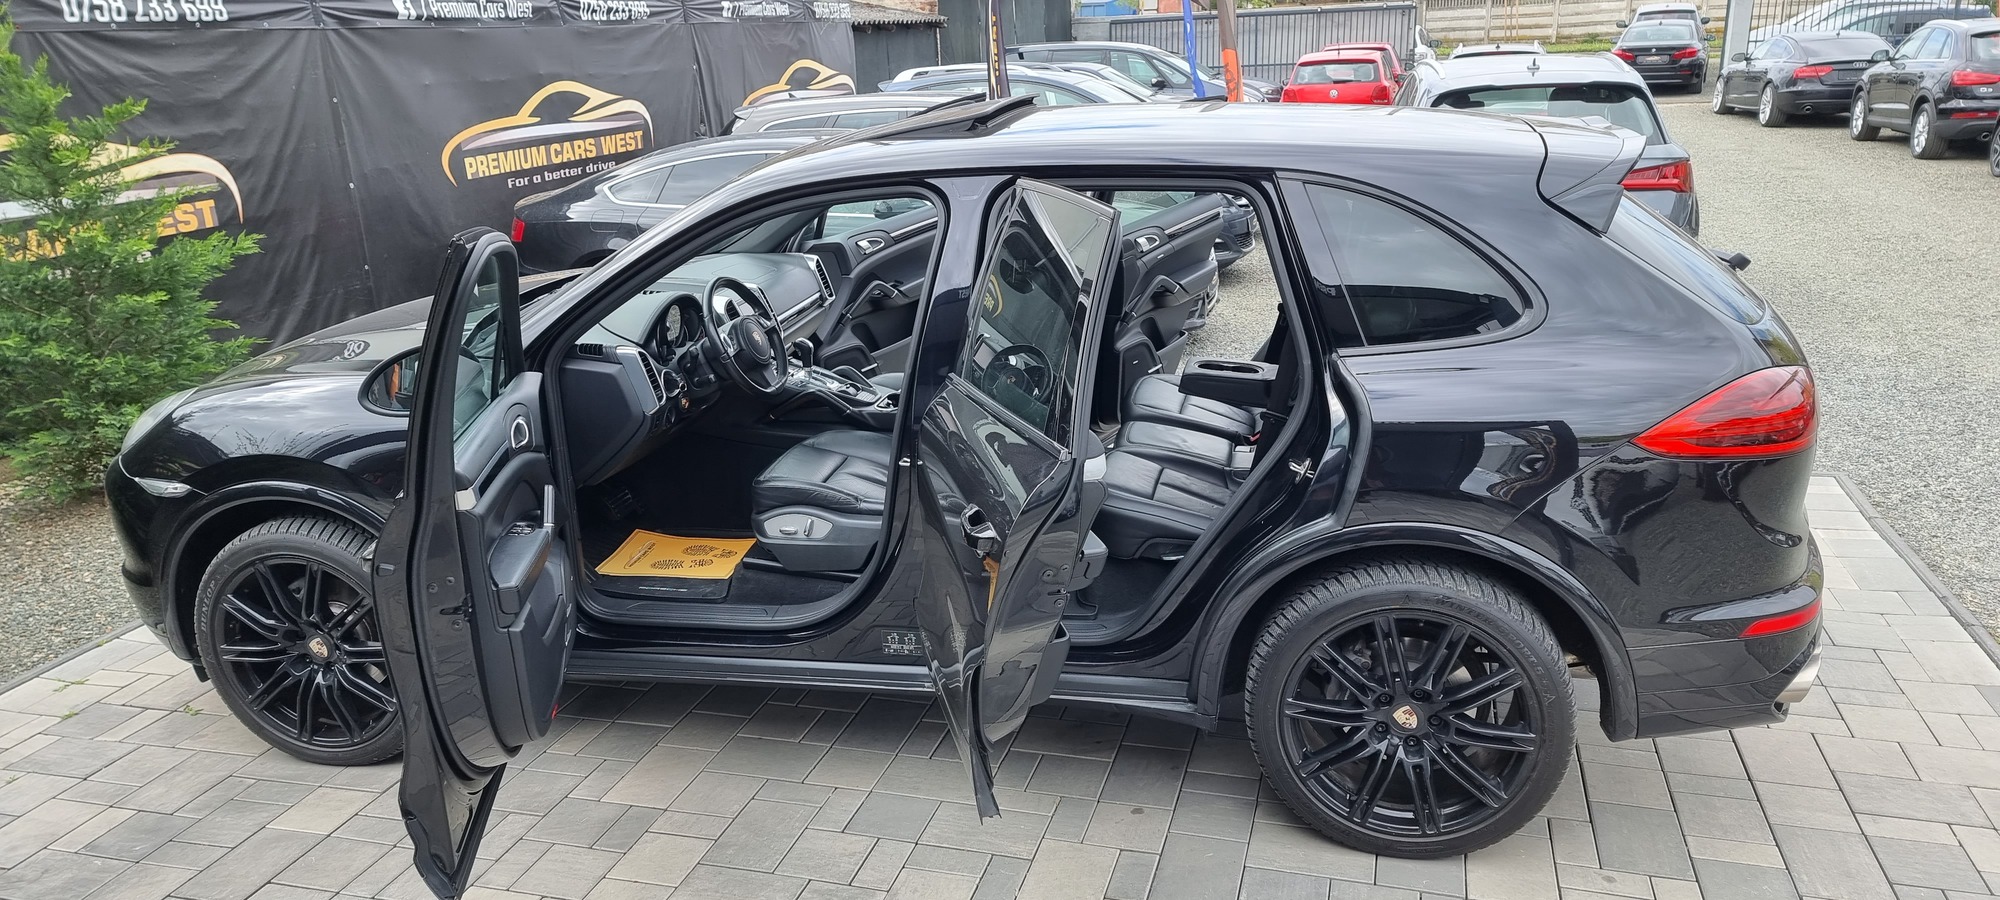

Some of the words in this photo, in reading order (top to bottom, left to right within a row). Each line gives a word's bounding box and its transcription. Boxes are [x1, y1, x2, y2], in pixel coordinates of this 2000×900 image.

[428, 0, 480, 18] Premium
[479, 0, 505, 18] Cars
[505, 0, 533, 18] West
[580, 0, 608, 21] 0758
[607, 1, 629, 20] 233
[463, 146, 547, 180] PREMIUM
[550, 137, 597, 164] CARS
[601, 130, 644, 155] WEST
[507, 175, 532, 189] For
[533, 174, 542, 184] a
[544, 166, 583, 182] better
[586, 160, 616, 174] drive
[202, 580, 216, 632] DUNLOP
[1435, 598, 1494, 626] WINTER
[1497, 625, 1538, 667] SPORT
